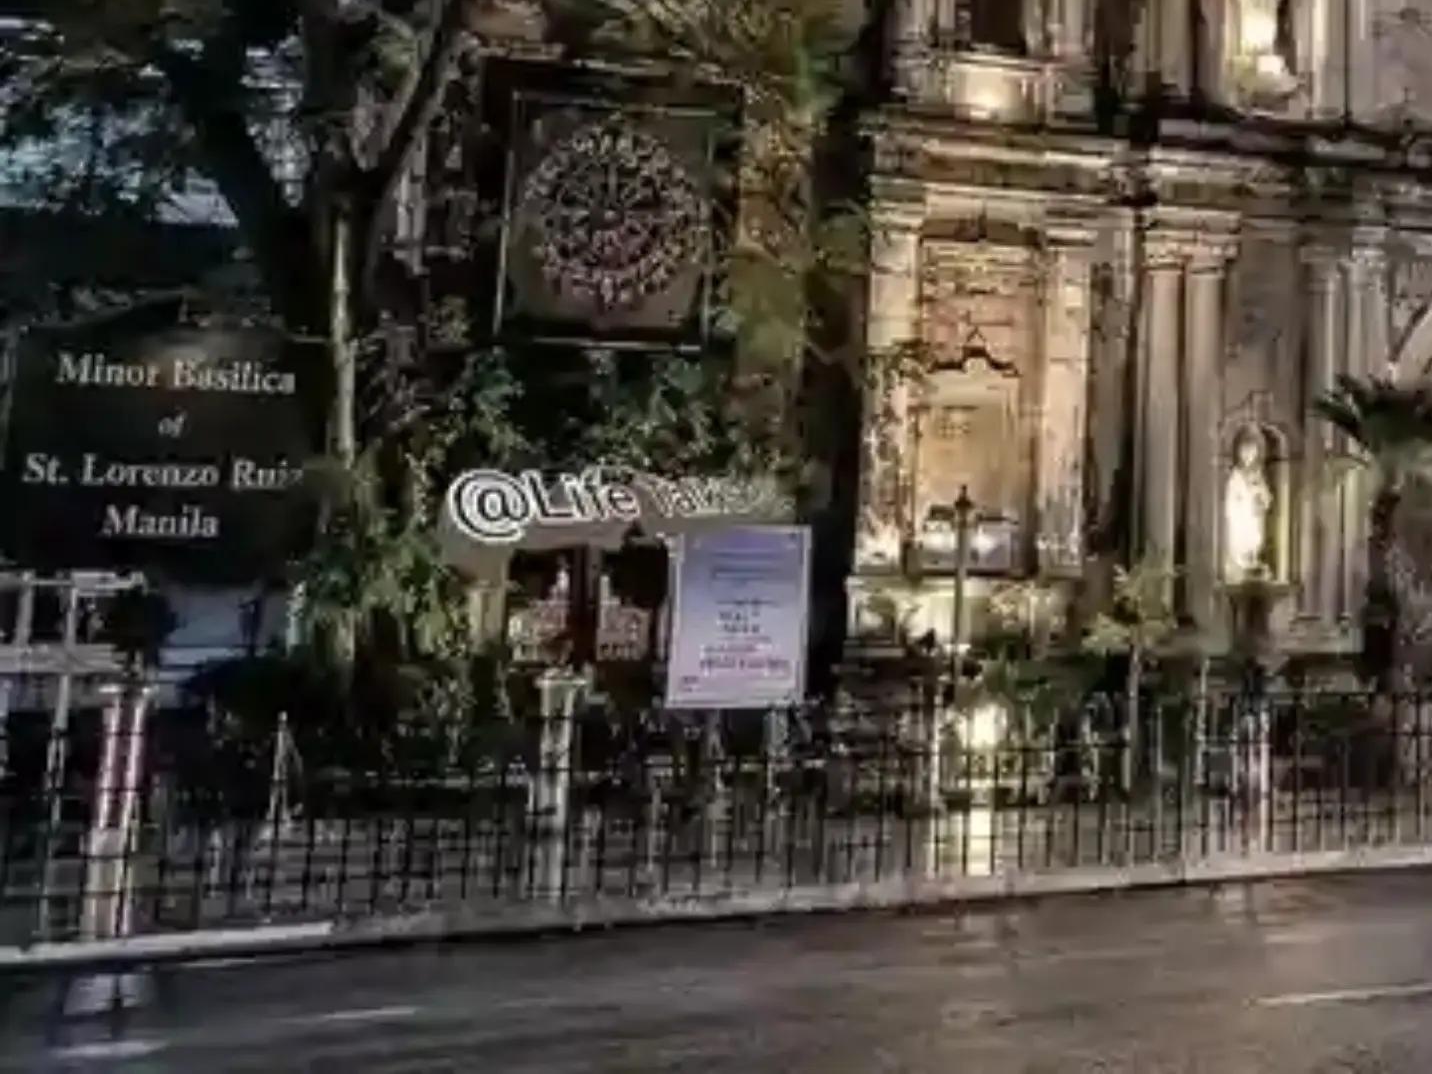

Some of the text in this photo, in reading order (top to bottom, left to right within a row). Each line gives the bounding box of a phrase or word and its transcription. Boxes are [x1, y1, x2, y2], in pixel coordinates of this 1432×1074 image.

[56, 353, 297, 394] Minor Basilica
[157, 412, 187, 438] of
[22, 453, 69, 486] St.
[79, 453, 219, 488] Lorenzo
[101, 504, 219, 538] Manila
